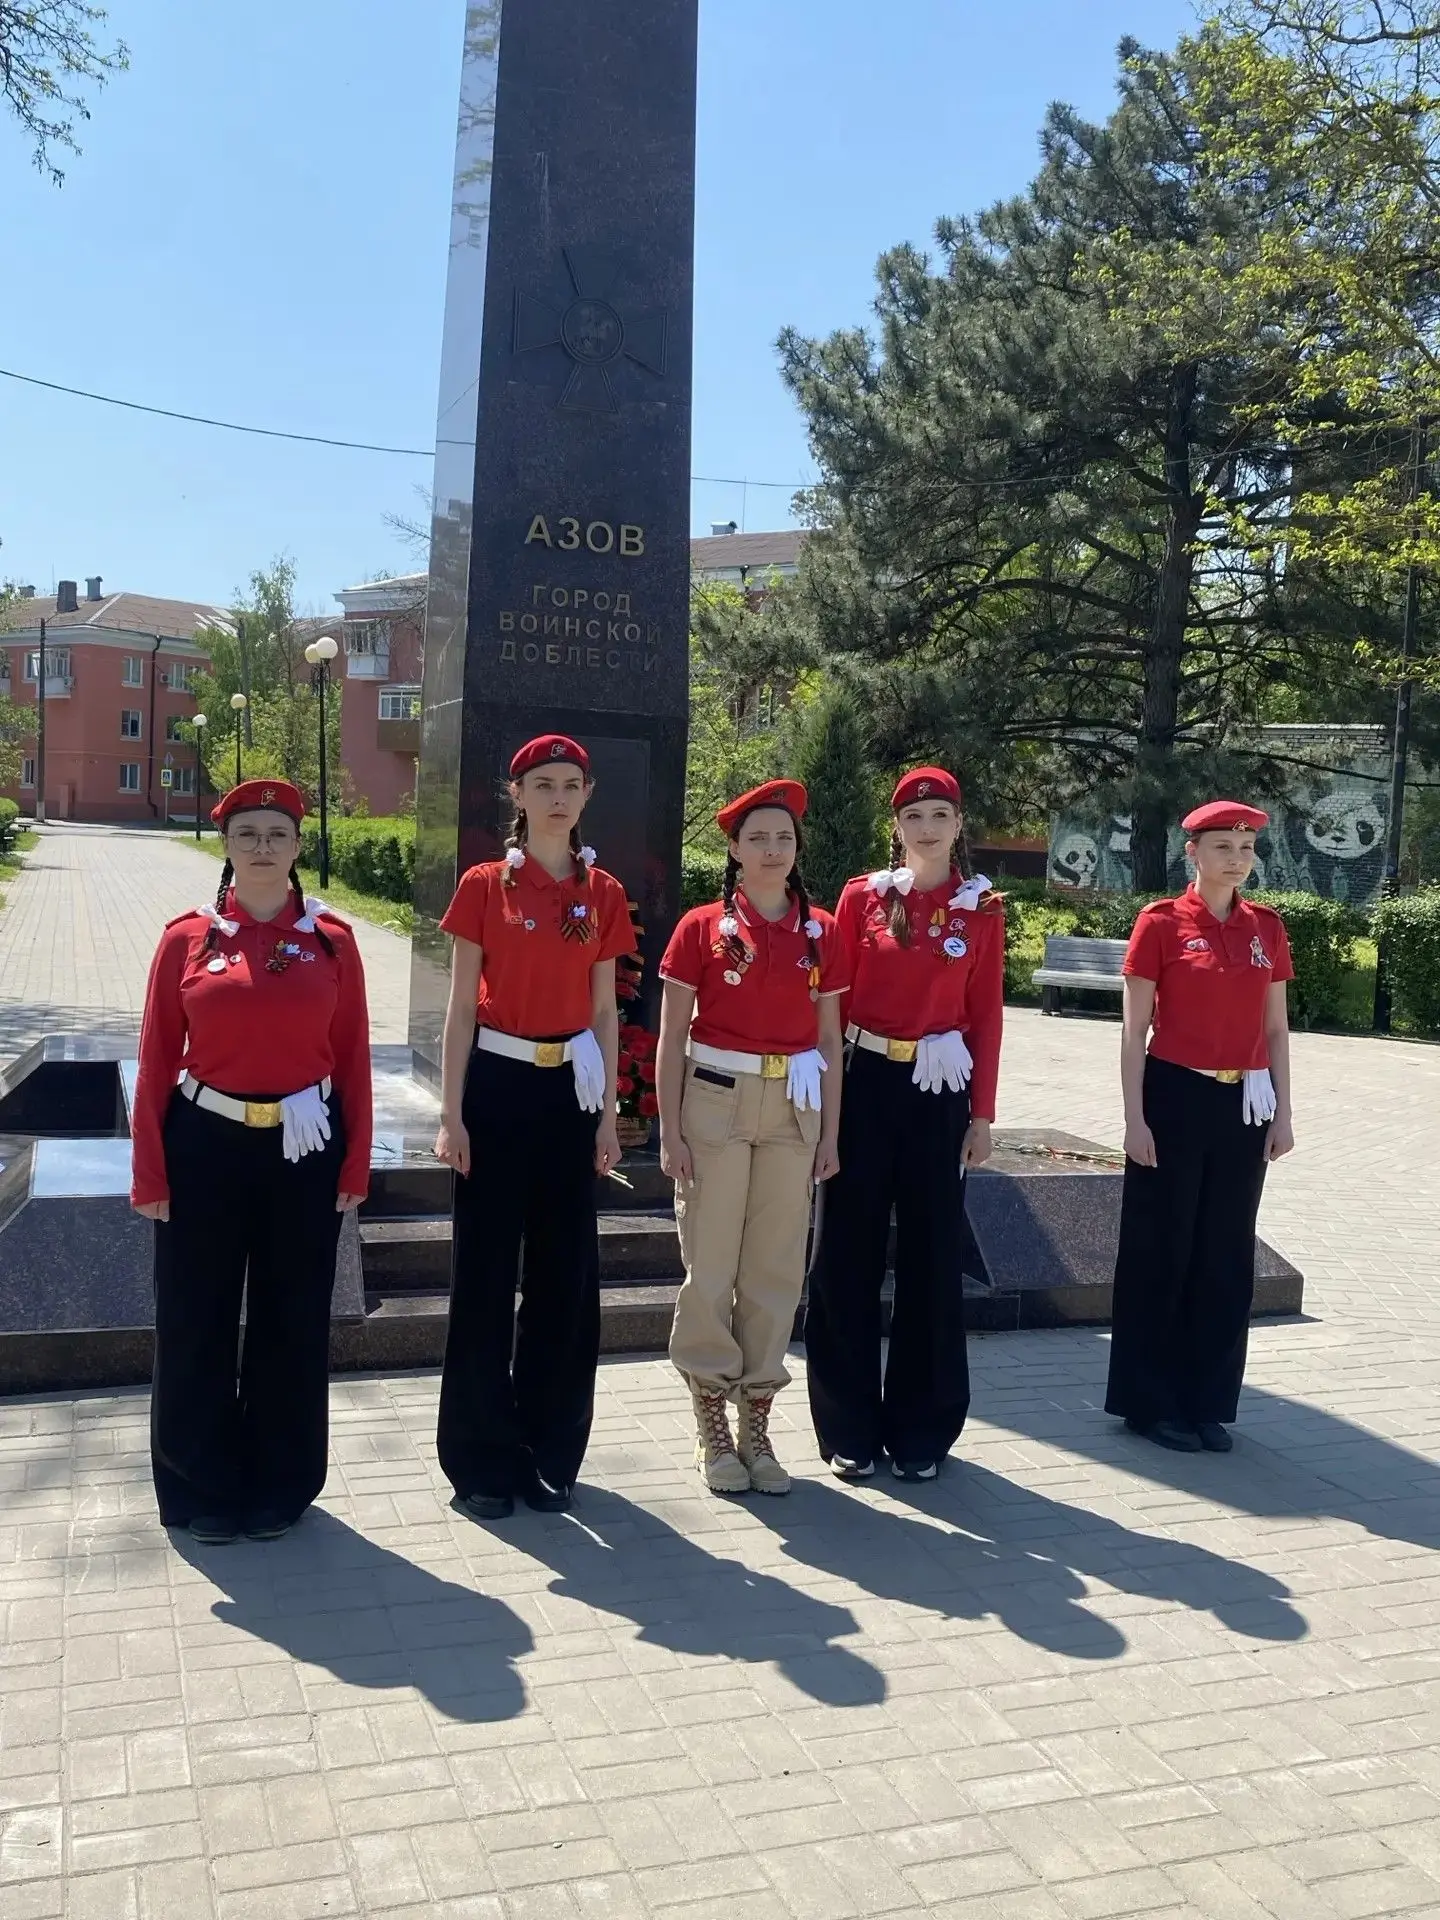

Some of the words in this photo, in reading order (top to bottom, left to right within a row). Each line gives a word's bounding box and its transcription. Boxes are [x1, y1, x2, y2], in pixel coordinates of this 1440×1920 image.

[524, 515, 645, 556] АЗОВ
[531, 584, 631, 618] ГОРОД
[499, 611, 661, 645] ВОИНСКОЙ
[499, 640, 659, 672] ДОБЛЕСТИ
